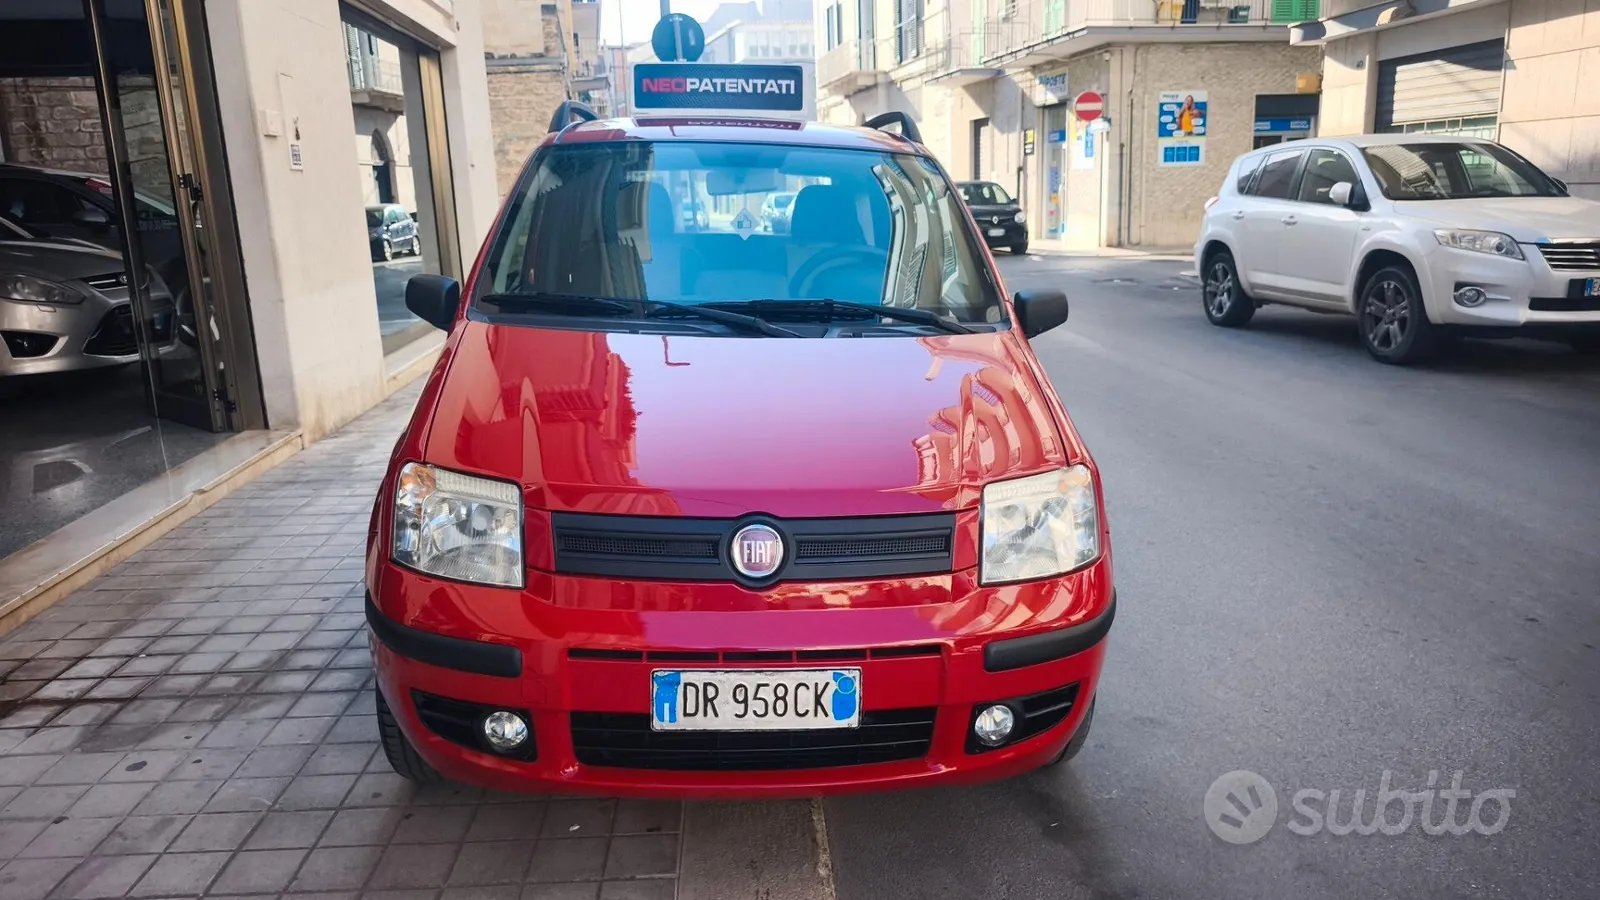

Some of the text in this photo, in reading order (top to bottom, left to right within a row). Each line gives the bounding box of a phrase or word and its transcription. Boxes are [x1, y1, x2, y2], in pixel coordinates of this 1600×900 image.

[642, 78, 795, 94] NEOPATENTATI
[743, 540, 773, 564] FIAT
[683, 681, 719, 718] DR
[732, 681, 830, 718] 958CK
